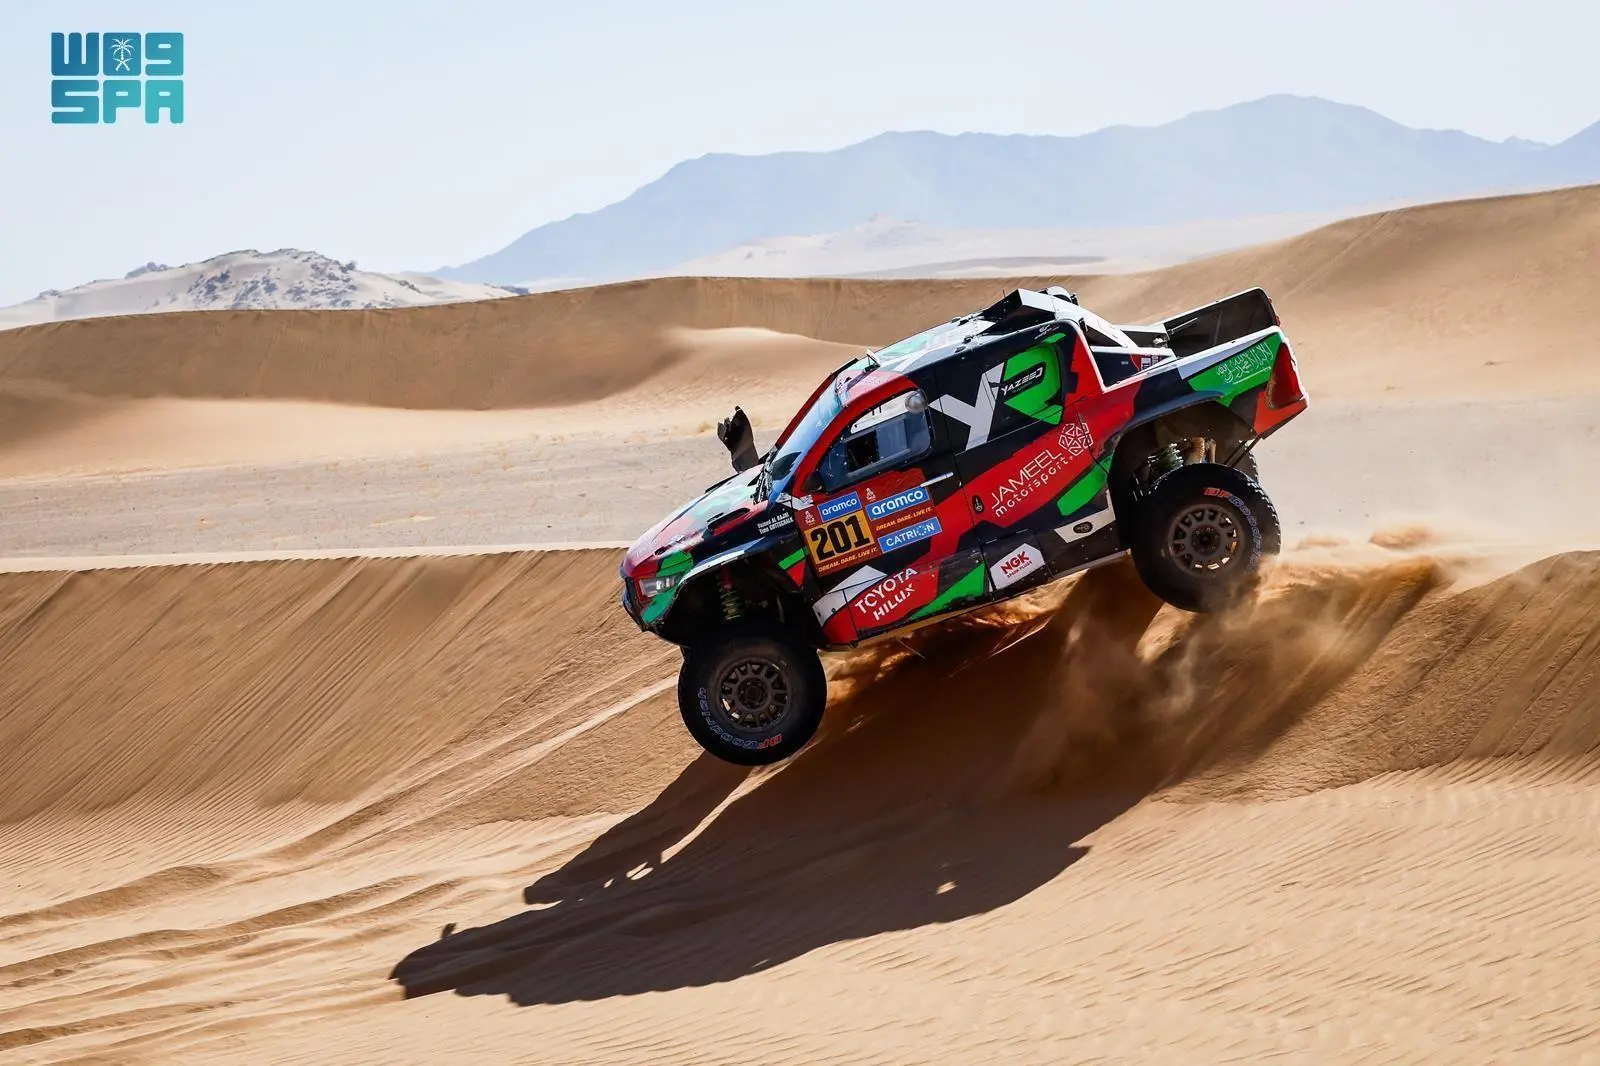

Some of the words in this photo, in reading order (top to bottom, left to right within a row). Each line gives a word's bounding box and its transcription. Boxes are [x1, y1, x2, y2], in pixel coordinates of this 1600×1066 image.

[991, 449, 1062, 510] JAMEEL
[995, 457, 1069, 517] motorsport
[821, 498, 858, 516] aramco
[871, 490, 924, 515] aramco
[810, 514, 871, 561] 201
[858, 549, 871, 558] LIVE
[1000, 551, 1030, 575] NGK
[854, 567, 918, 615] TOYOTA
[872, 583, 916, 621] HILUX
